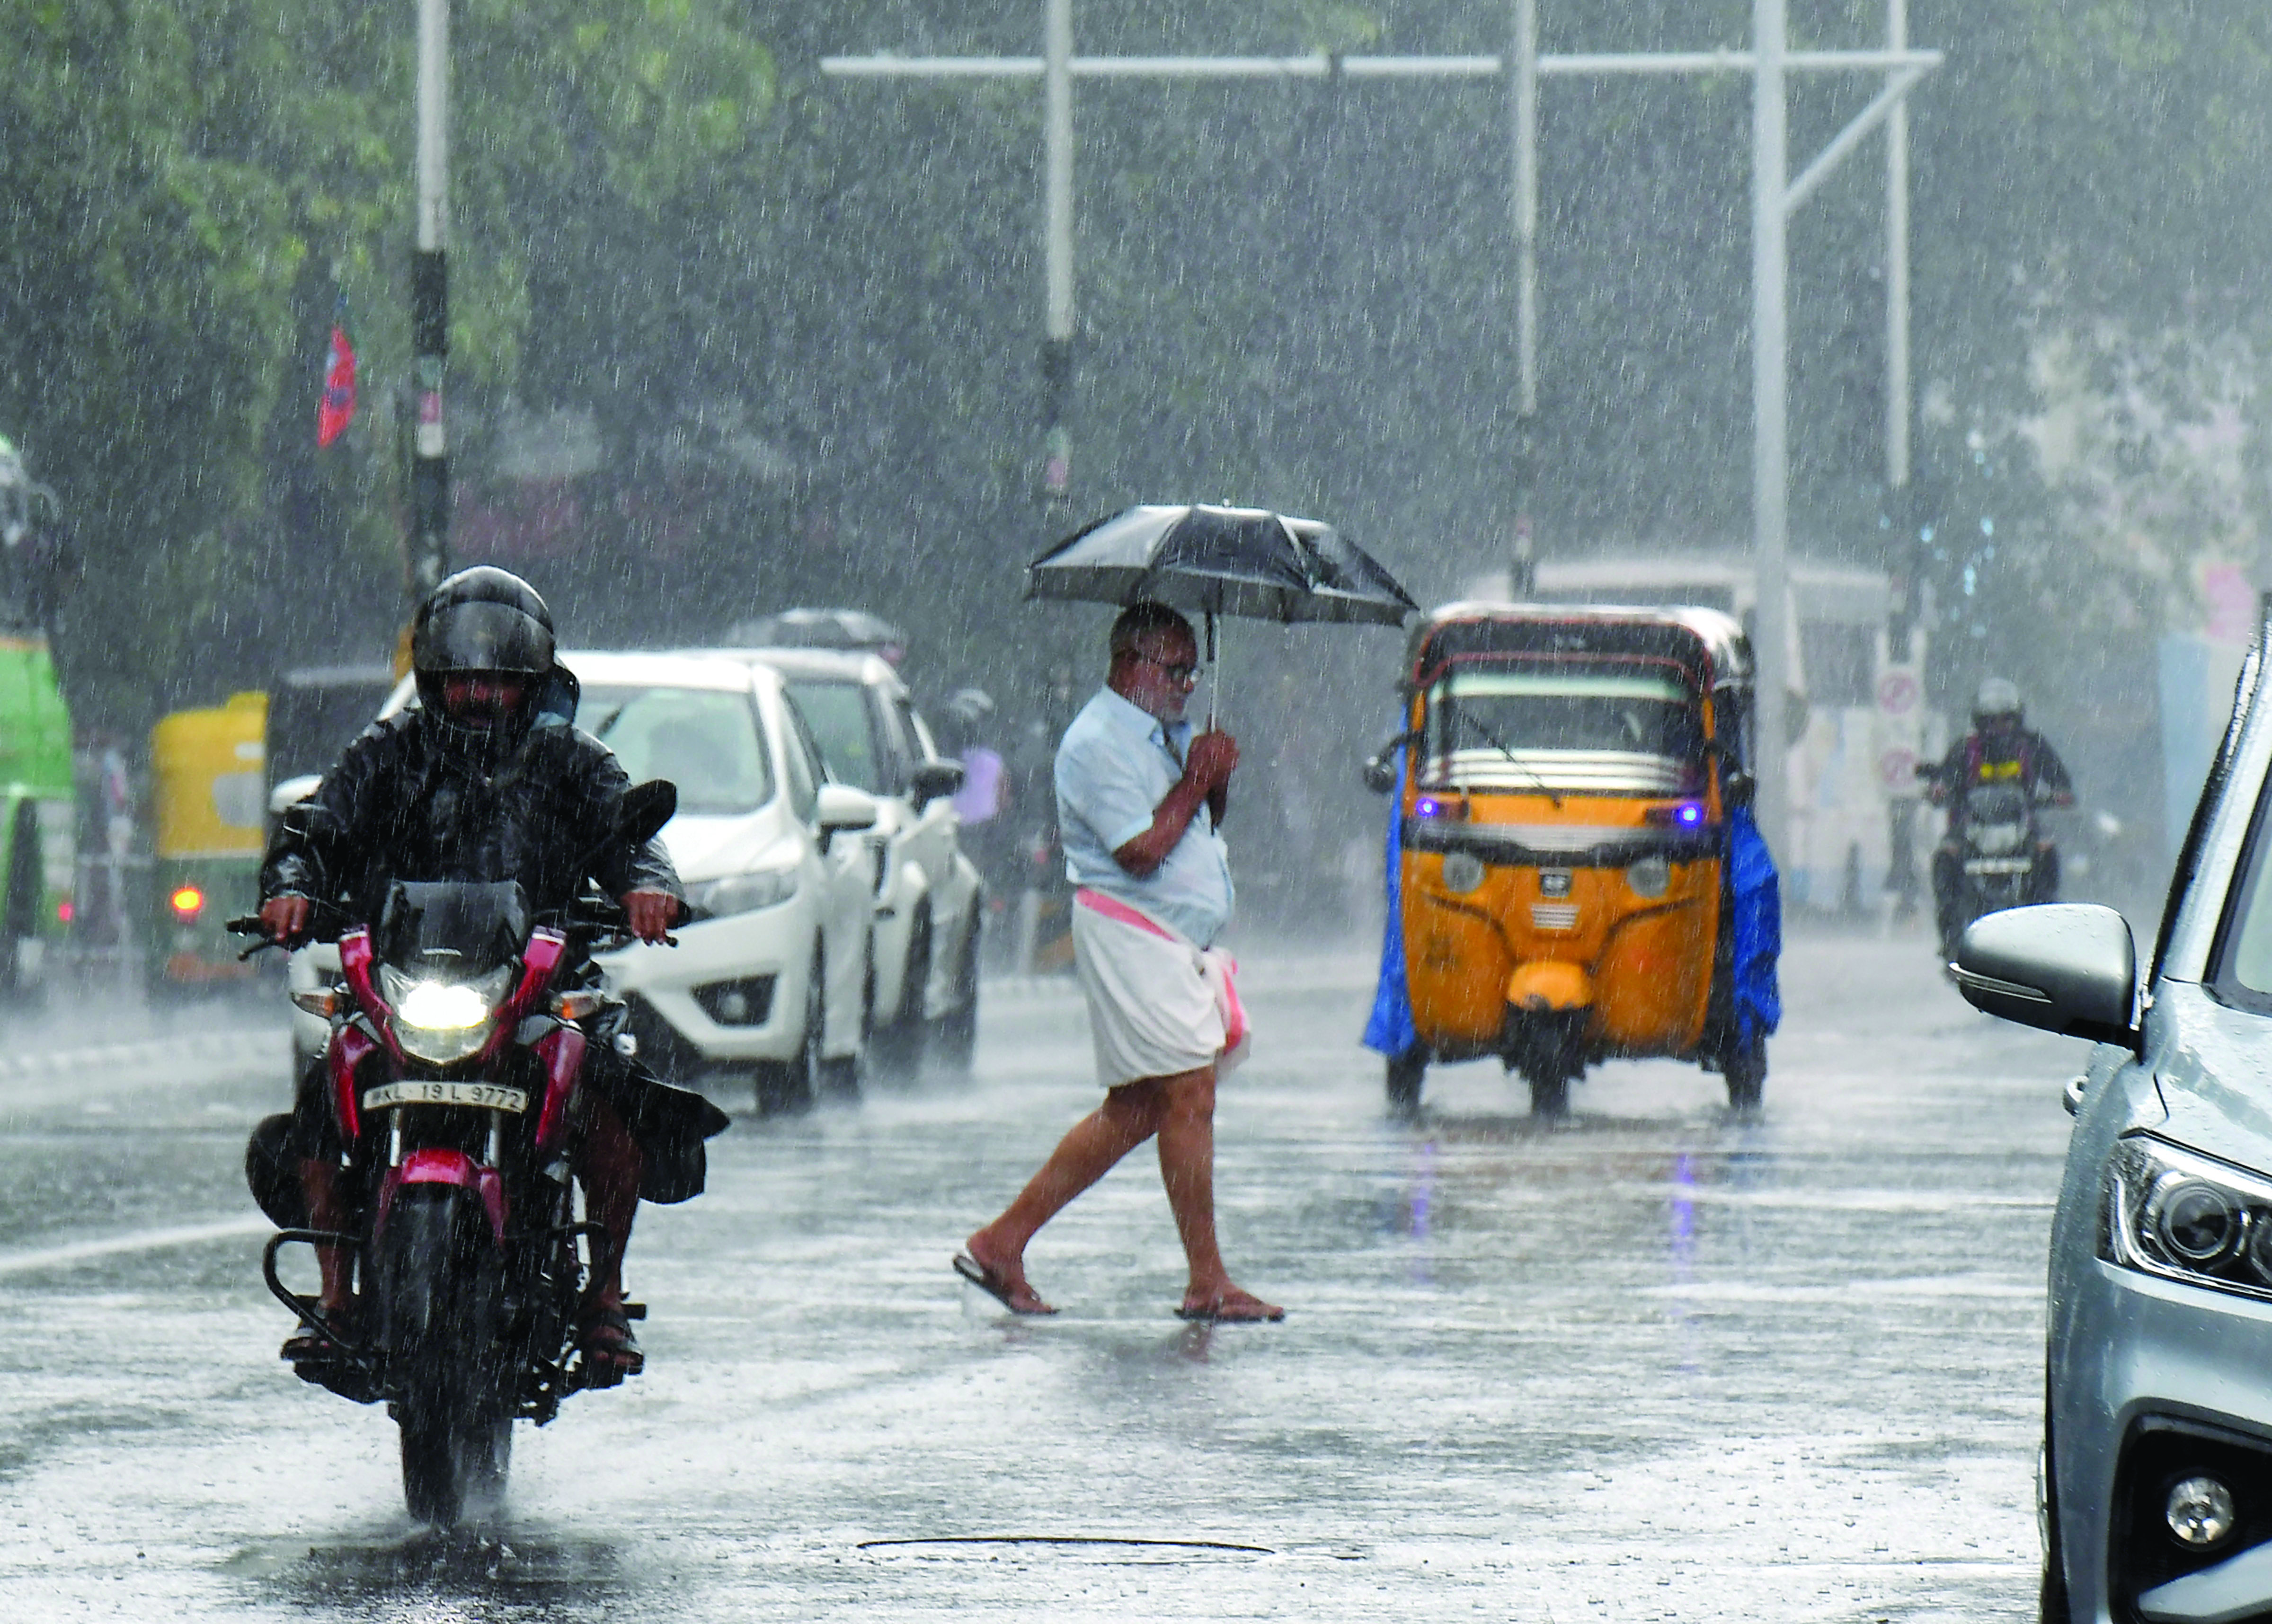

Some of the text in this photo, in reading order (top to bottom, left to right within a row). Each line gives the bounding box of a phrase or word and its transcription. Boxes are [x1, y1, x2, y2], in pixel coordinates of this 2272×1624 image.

[423, 1084, 442, 1099] 19
[452, 1085, 460, 1100] L
[472, 1086, 520, 1108] 9772
